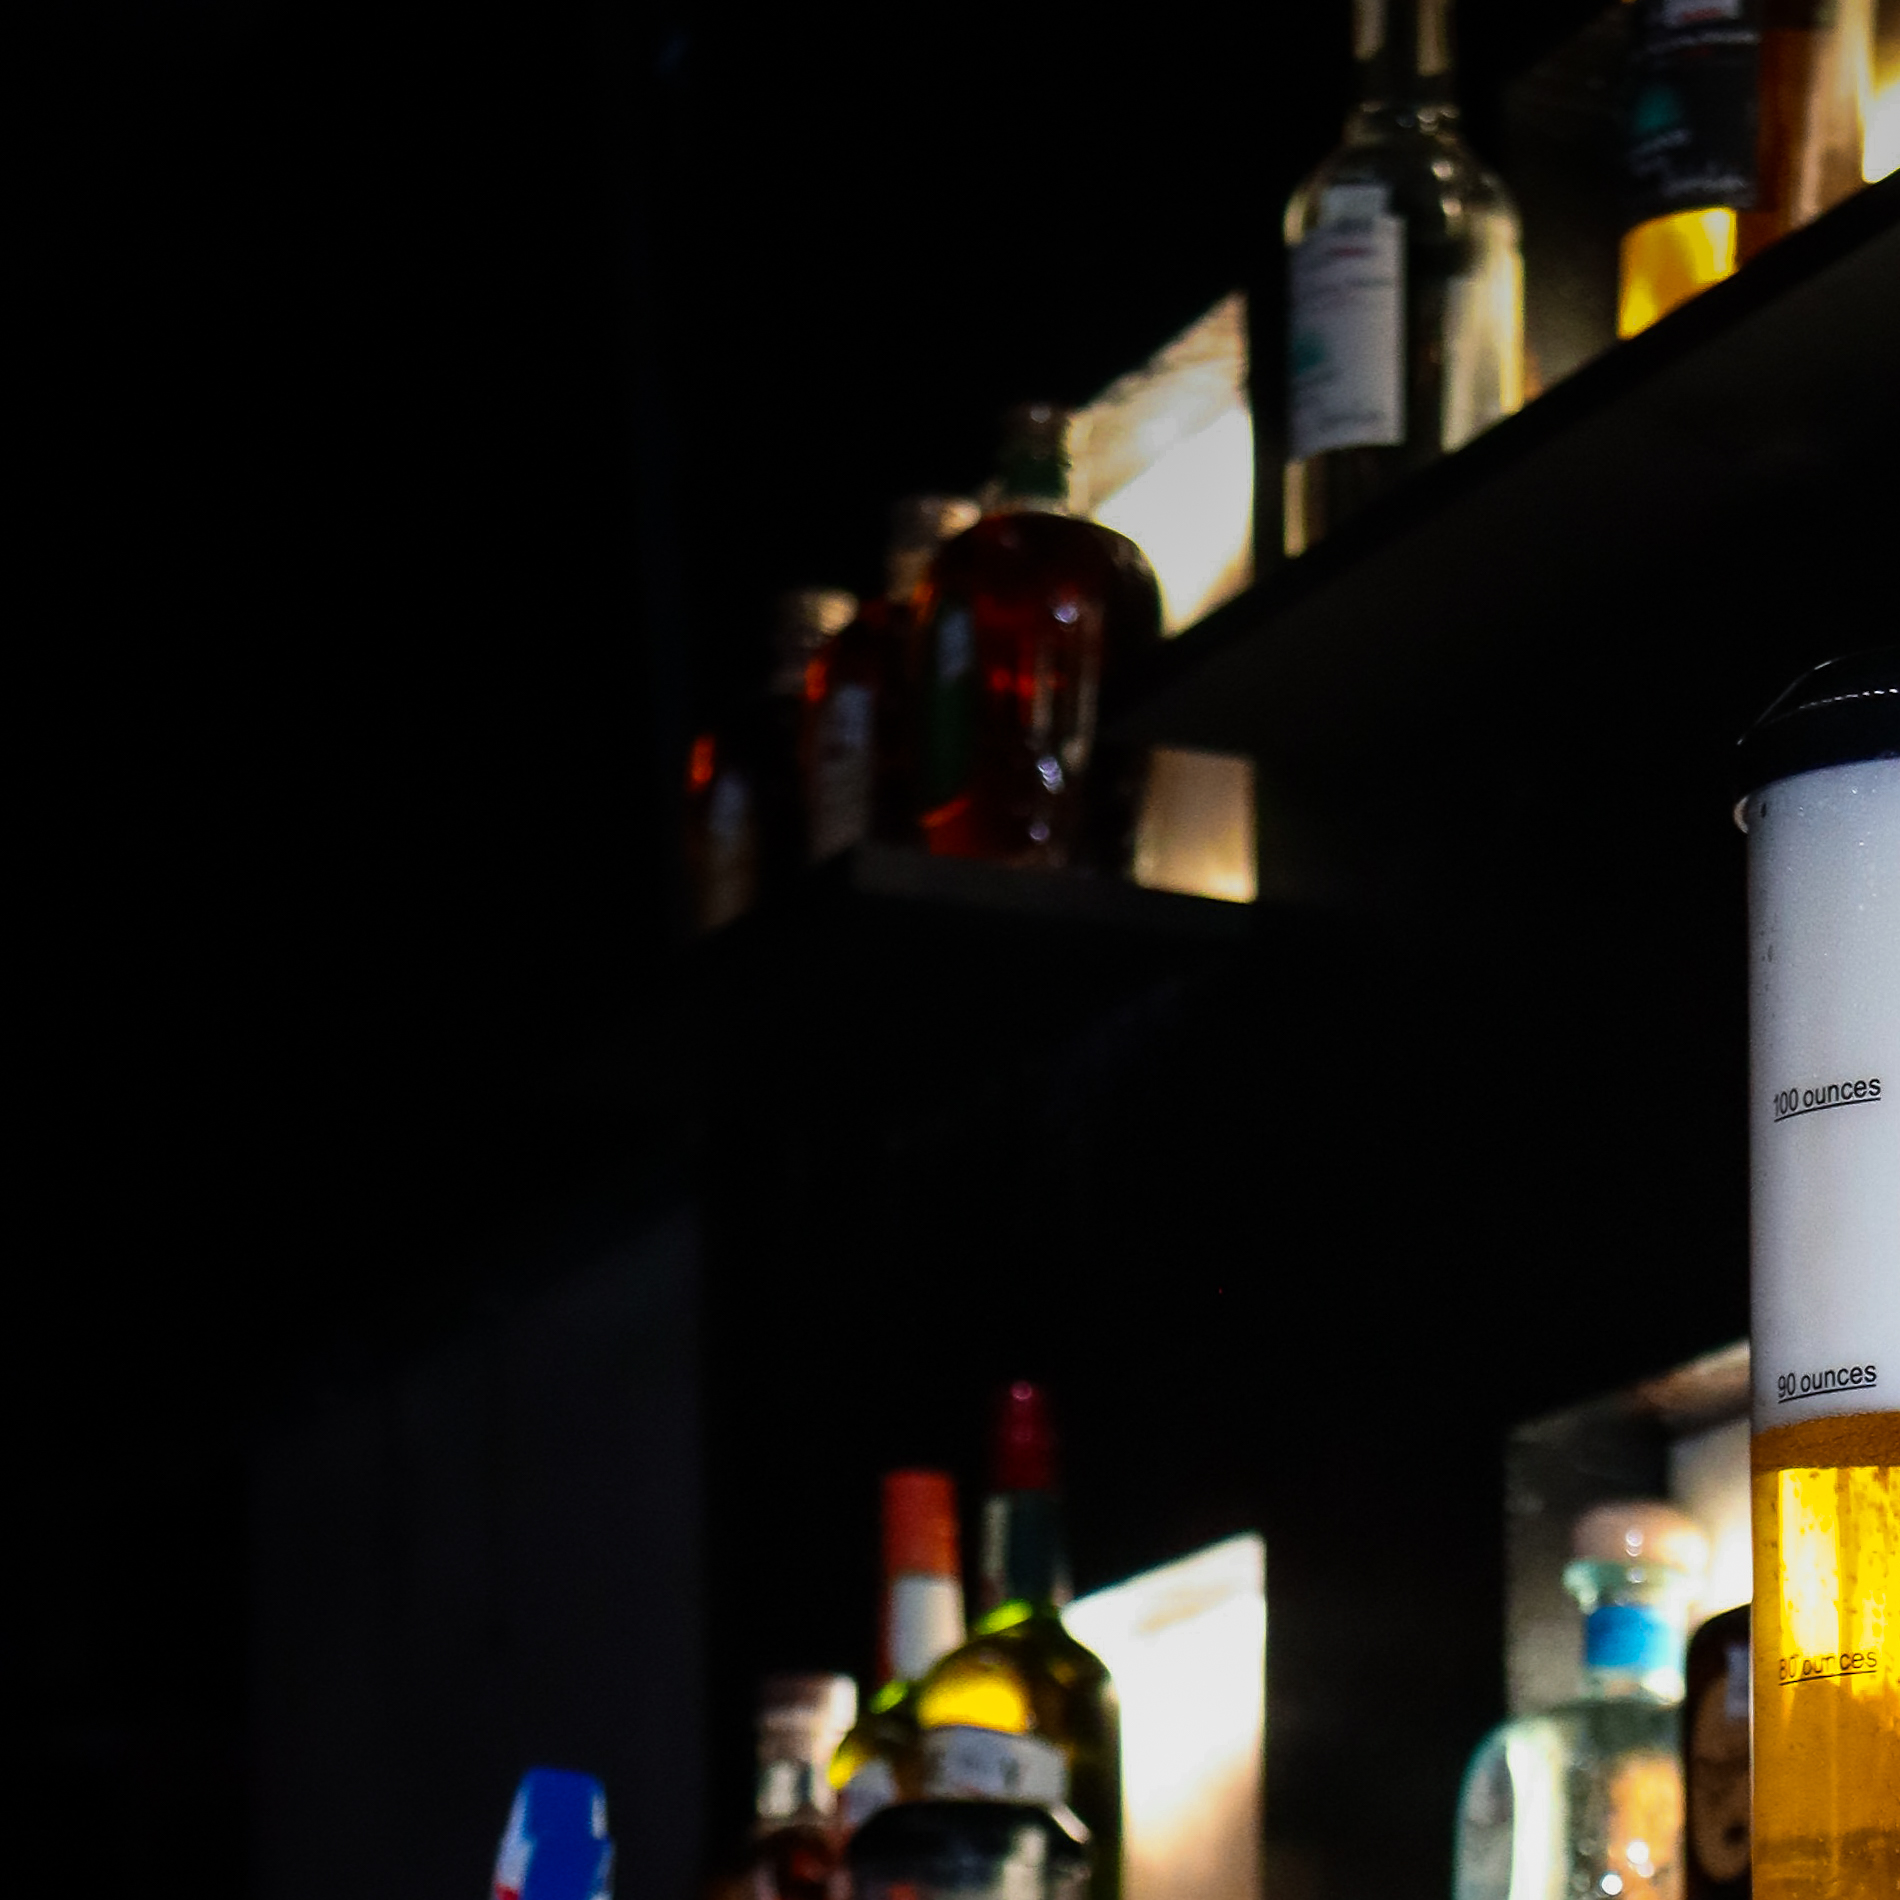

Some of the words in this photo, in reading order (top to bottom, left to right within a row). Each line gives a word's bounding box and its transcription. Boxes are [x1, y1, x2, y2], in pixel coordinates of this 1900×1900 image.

[1774, 1088, 1799, 1117] 100
[1803, 1079, 1881, 1108] ounces
[1778, 1373, 1796, 1398] 90
[1800, 1365, 1877, 1393] ounces
